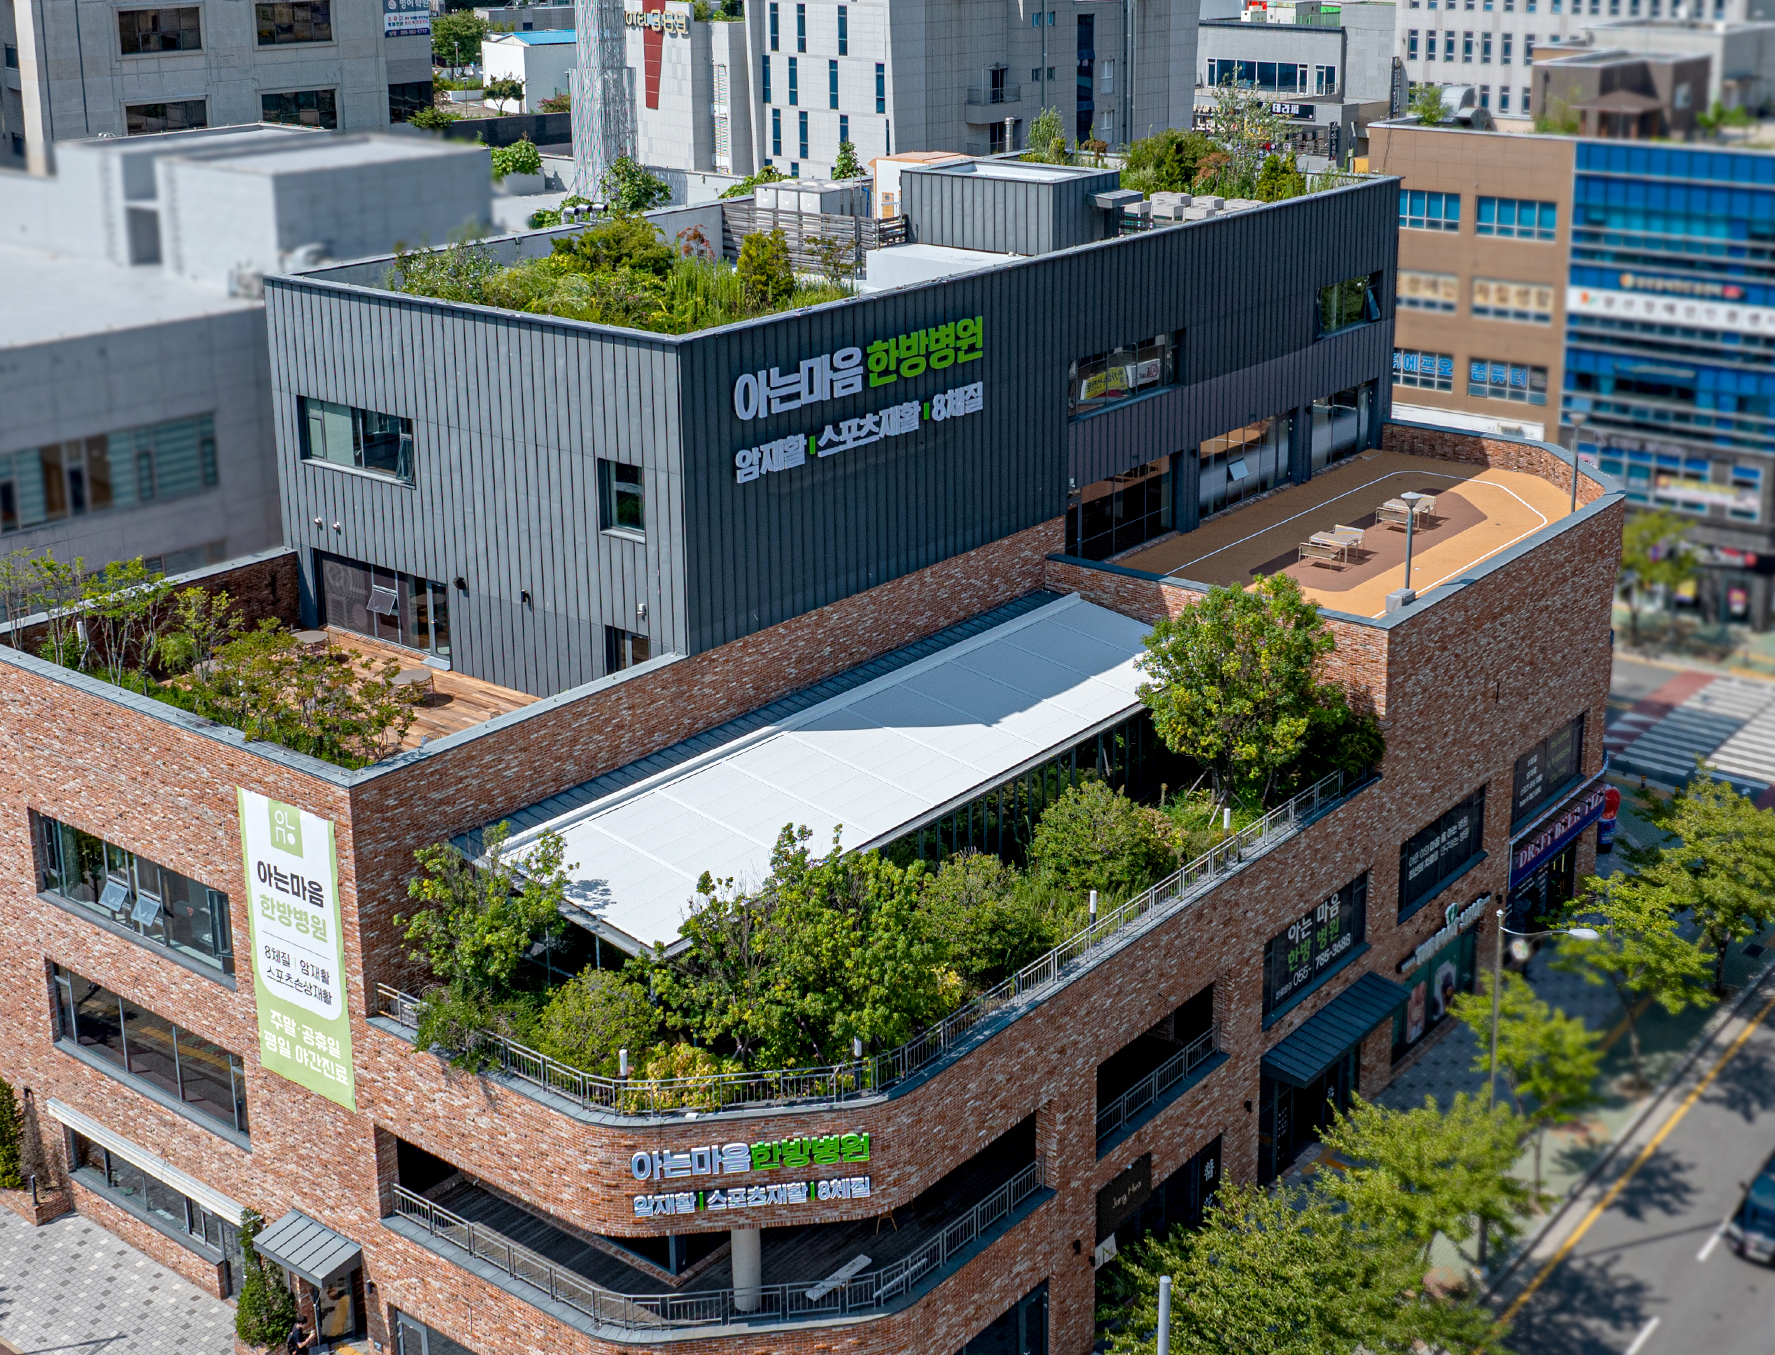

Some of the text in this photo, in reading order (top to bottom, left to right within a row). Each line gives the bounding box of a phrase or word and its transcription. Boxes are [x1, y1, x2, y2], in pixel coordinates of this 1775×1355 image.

[626, 11, 649, 27] OTEL
[734, 315, 983, 421] 아는마음 한방병원
[1471, 362, 1527, 387] 컴퓨터
[735, 381, 984, 484] 암재활 스포츠재활 8체질
[1519, 828, 1554, 869] DRAFT
[1554, 806, 1581, 840] BEER
[257, 860, 325, 908] 아는마음
[259, 893, 328, 943] 한방병원
[1287, 893, 1340, 944] 아는 마음
[264, 945, 330, 986] 8체질 암재활
[1287, 916, 1340, 972] 한방 병원
[266, 965, 333, 1006] 스포츠손상재활
[263, 1029, 349, 1086] 평일 야간진료
[631, 1131, 870, 1181] 아는마음 한방병원
[633, 1176, 871, 1218] 암재활 스포츠재활 8체질
